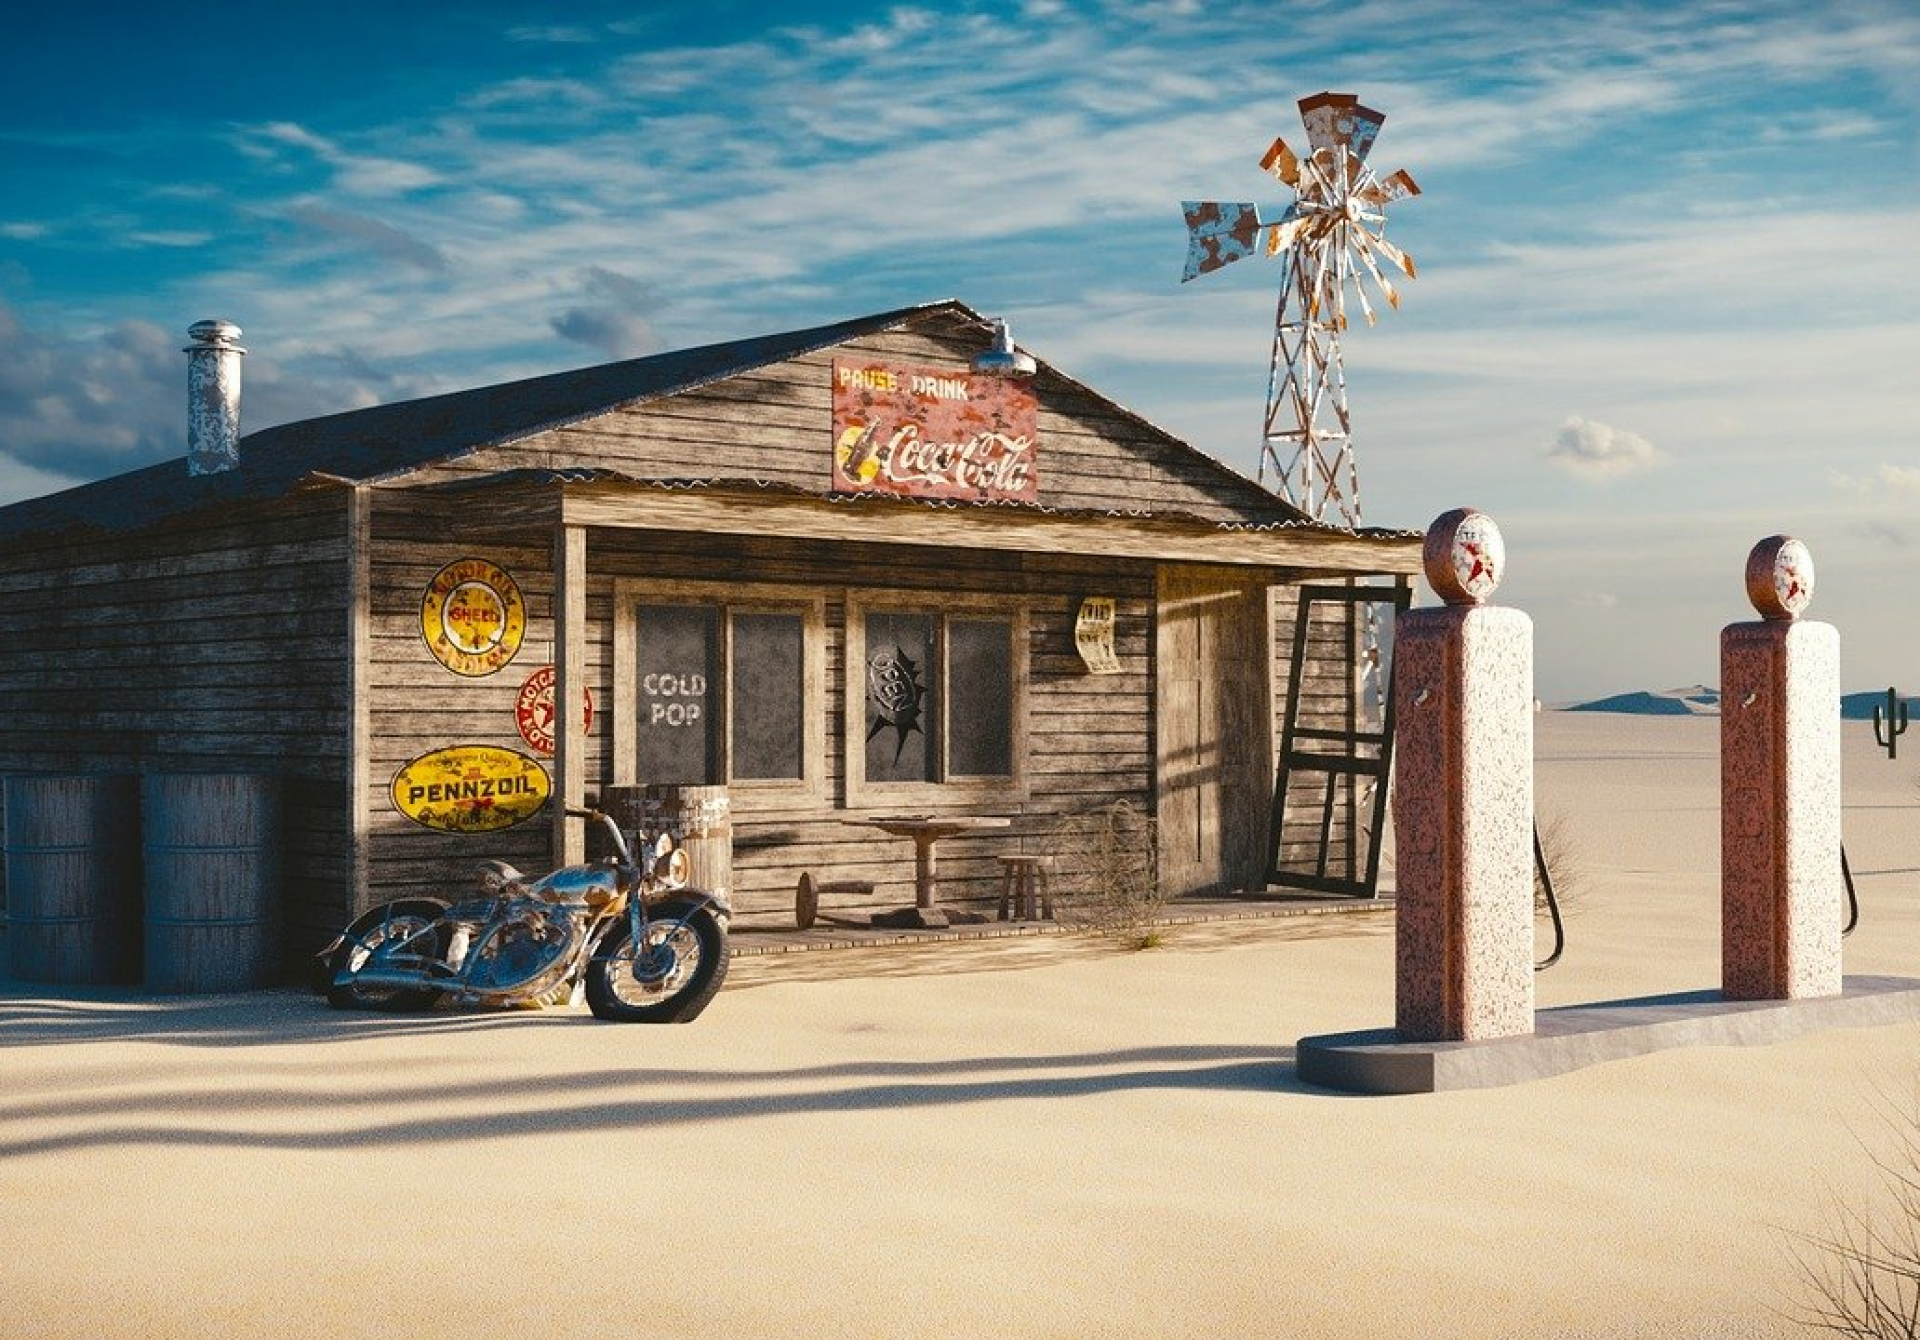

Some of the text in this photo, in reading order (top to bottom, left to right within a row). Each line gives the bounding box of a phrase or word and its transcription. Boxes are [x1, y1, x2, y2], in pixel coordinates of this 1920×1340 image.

[643, 673, 706, 696] COLD
[651, 703, 701, 726] POP
[409, 775, 537, 805] PENNZOIL
